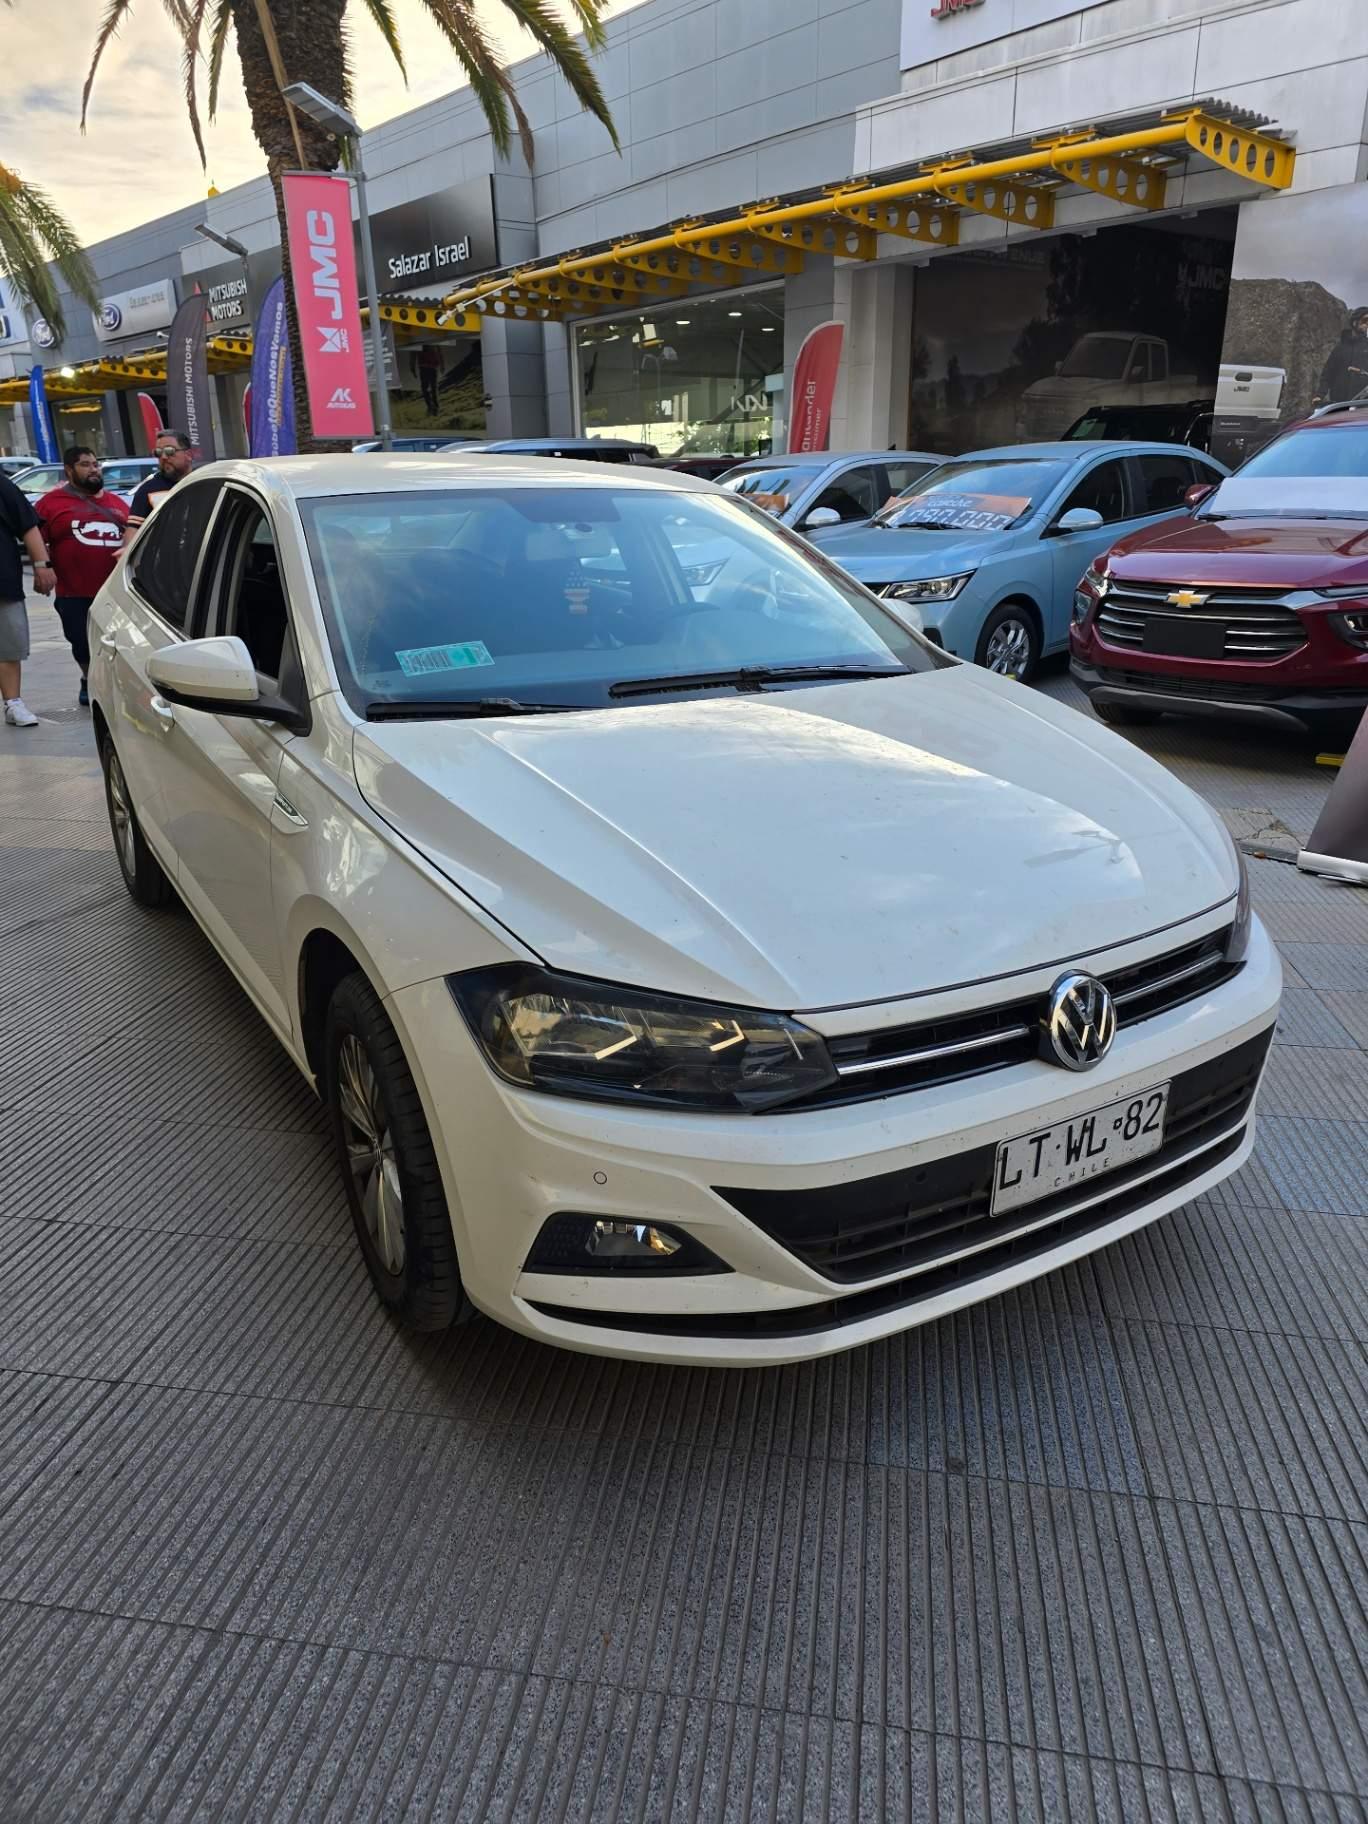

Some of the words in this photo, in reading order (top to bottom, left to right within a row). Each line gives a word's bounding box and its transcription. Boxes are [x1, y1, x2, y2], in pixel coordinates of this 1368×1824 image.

[306, 209, 343, 320] JMC
[388, 252, 431, 278] Salazar
[434, 235, 469, 267] Israel
[208, 278, 248, 303] MITSUBISH
[211, 300, 242, 321] MOTORS
[183, 337, 193, 384] MOTORS
[186, 385, 200, 446] MITSUBISHI
[802, 379, 816, 451] antander
[1054, 1157, 1111, 1187] CHILE
